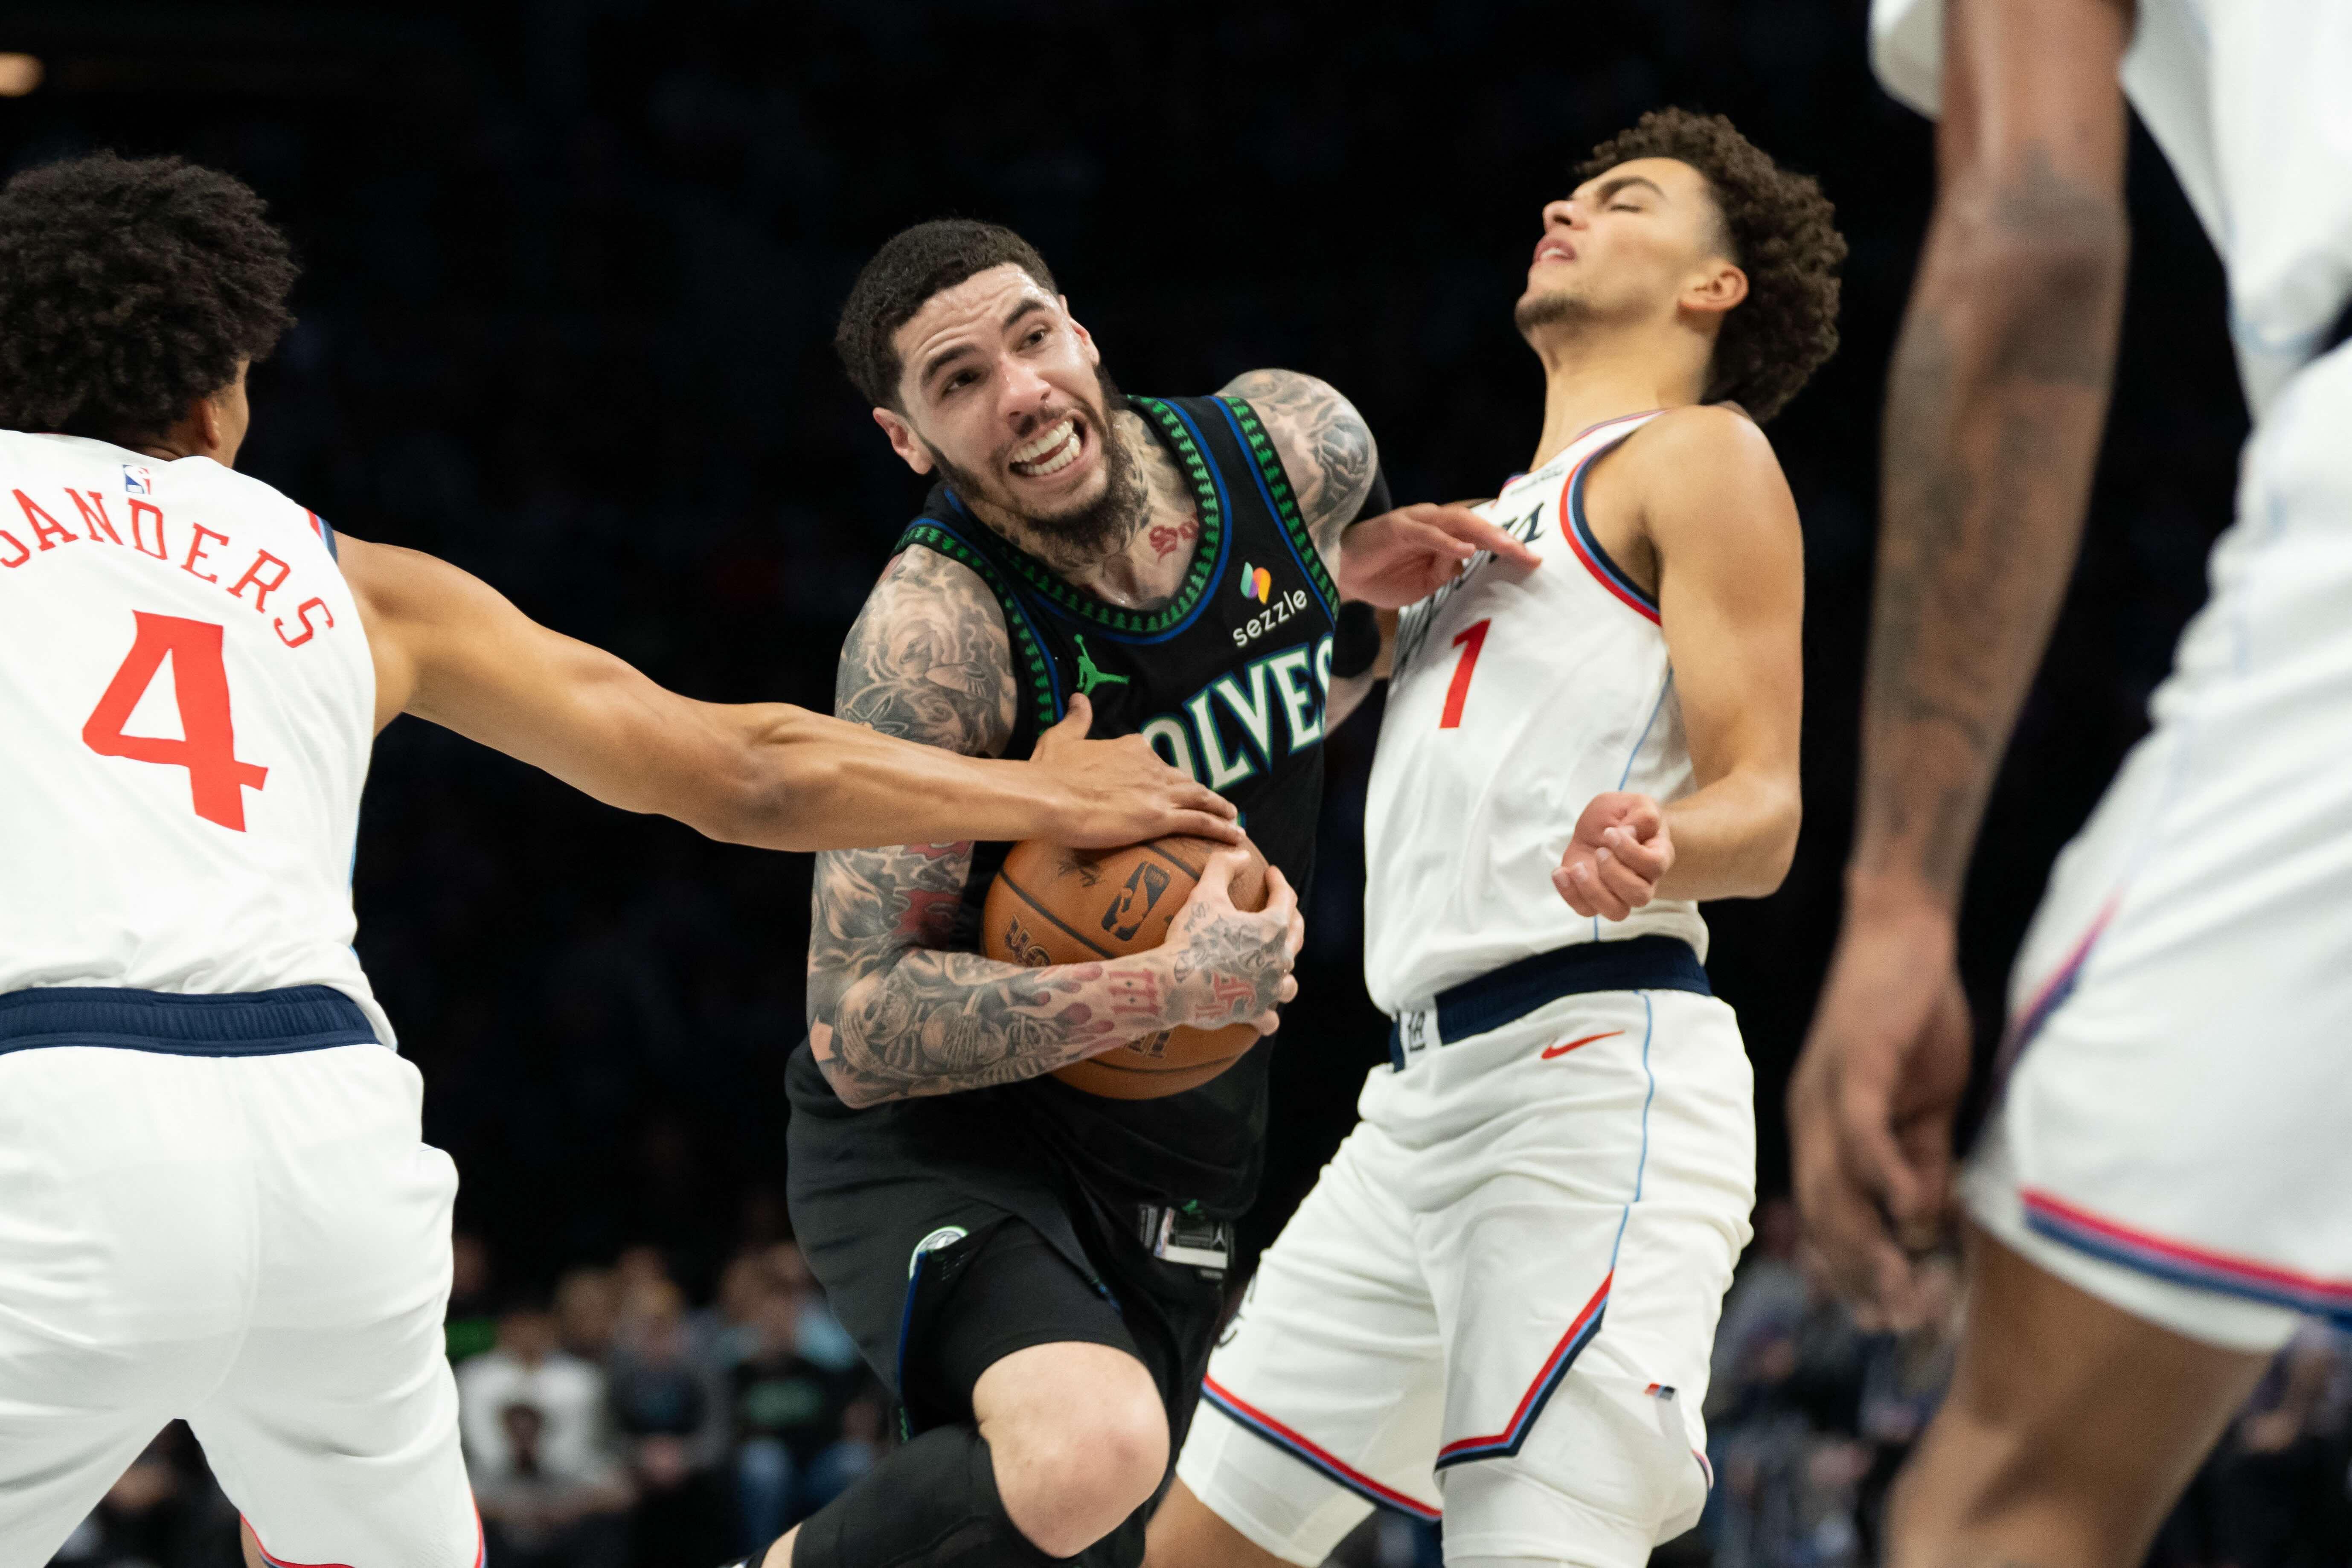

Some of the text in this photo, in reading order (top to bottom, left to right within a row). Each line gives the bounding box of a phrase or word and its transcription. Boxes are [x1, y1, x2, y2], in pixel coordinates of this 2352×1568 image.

[1233, 590, 1308, 647] sezzle
[1439, 617, 1491, 729] 1
[82, 609, 268, 833] 4
[1140, 633, 1333, 792] OLVE
